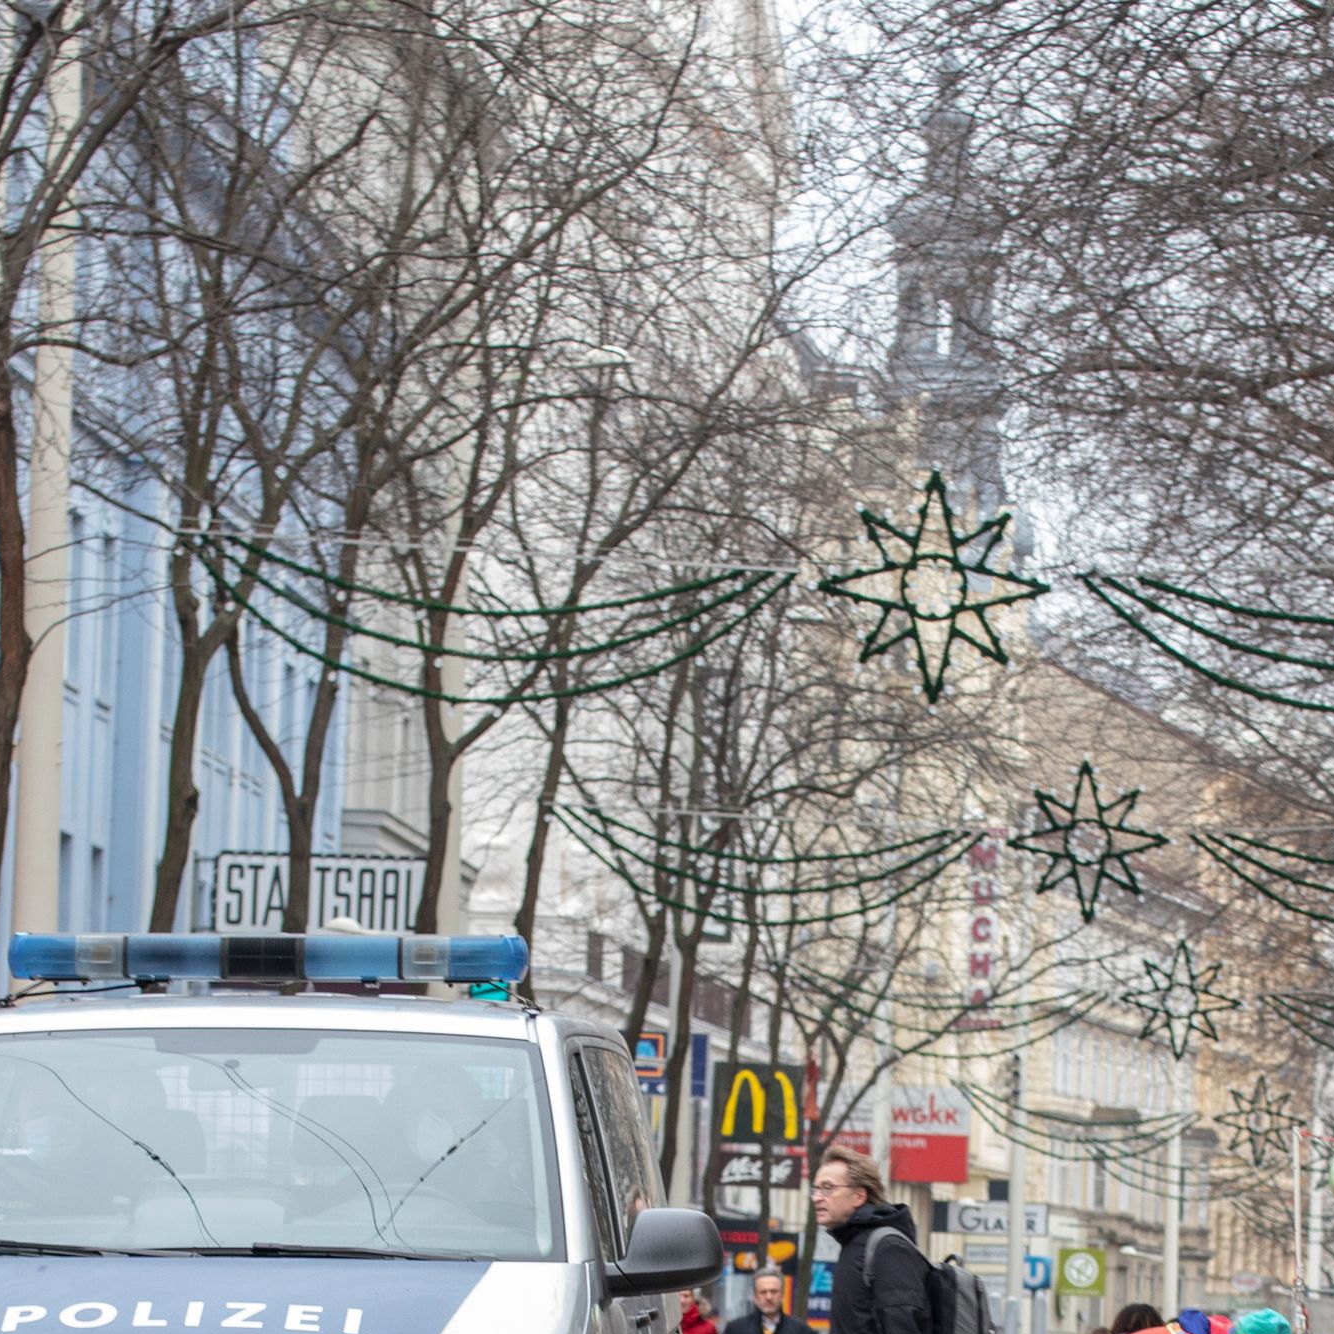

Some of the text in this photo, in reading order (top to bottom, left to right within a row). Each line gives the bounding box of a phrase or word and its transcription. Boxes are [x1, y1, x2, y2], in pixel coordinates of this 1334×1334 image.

[225, 863, 418, 931] STATSAAL
[958, 1206, 1036, 1232] GLAR
[0, 1301, 364, 1334] POLIZEI
